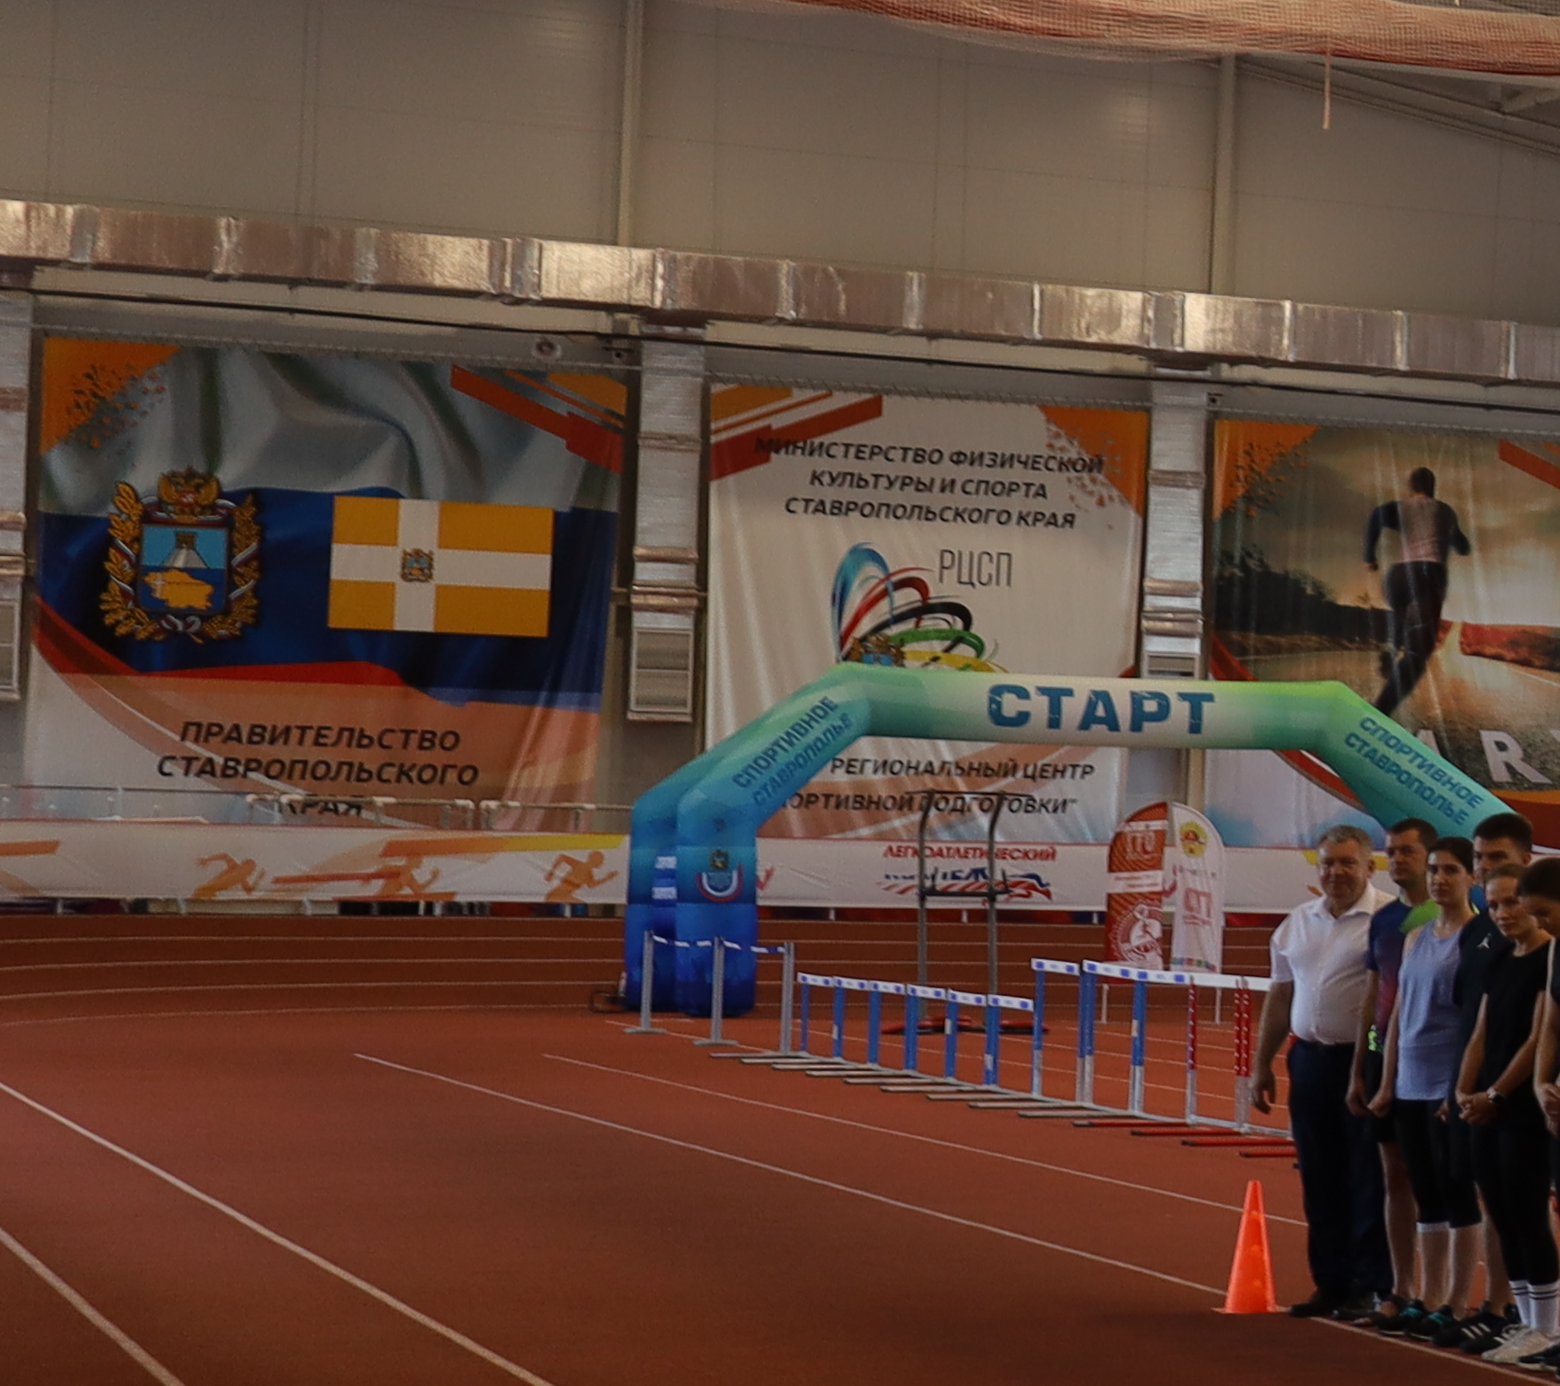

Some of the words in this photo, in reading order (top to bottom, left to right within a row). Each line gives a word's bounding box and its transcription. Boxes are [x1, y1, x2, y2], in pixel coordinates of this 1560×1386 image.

[755, 438, 944, 466] МИНИСТЕРСТВО
[949, 448, 1105, 475] ФИЗИЧЕСКОЙ
[809, 469, 934, 494] КУЛЬТУРЫ
[938, 476, 957, 494] И
[960, 479, 1048, 500] СПОРТА
[785, 496, 1012, 526] СТАВРОПОЛЬСКОГО
[1016, 512, 1077, 529] КРАЯ
[938, 549, 1013, 589] РЦСП
[987, 684, 1216, 735] СТАРТ
[179, 720, 461, 752] ПРАВИТЕЛЬСТВО
[732, 695, 840, 789] СПОРТИВНОЕ
[157, 754, 479, 787] СТАВРОПОЛЬСКОГО
[752, 711, 853, 806] СТАВРОПОЛЬЕ
[830, 757, 1018, 780] РЕГИОНАЛЬНЫЙ
[1022, 763, 1095, 782] ЦЕНТР
[1359, 716, 1485, 809] СПОРТИВНОЕ
[1344, 732, 1471, 826] СТАВРОПОЛЬЕ
